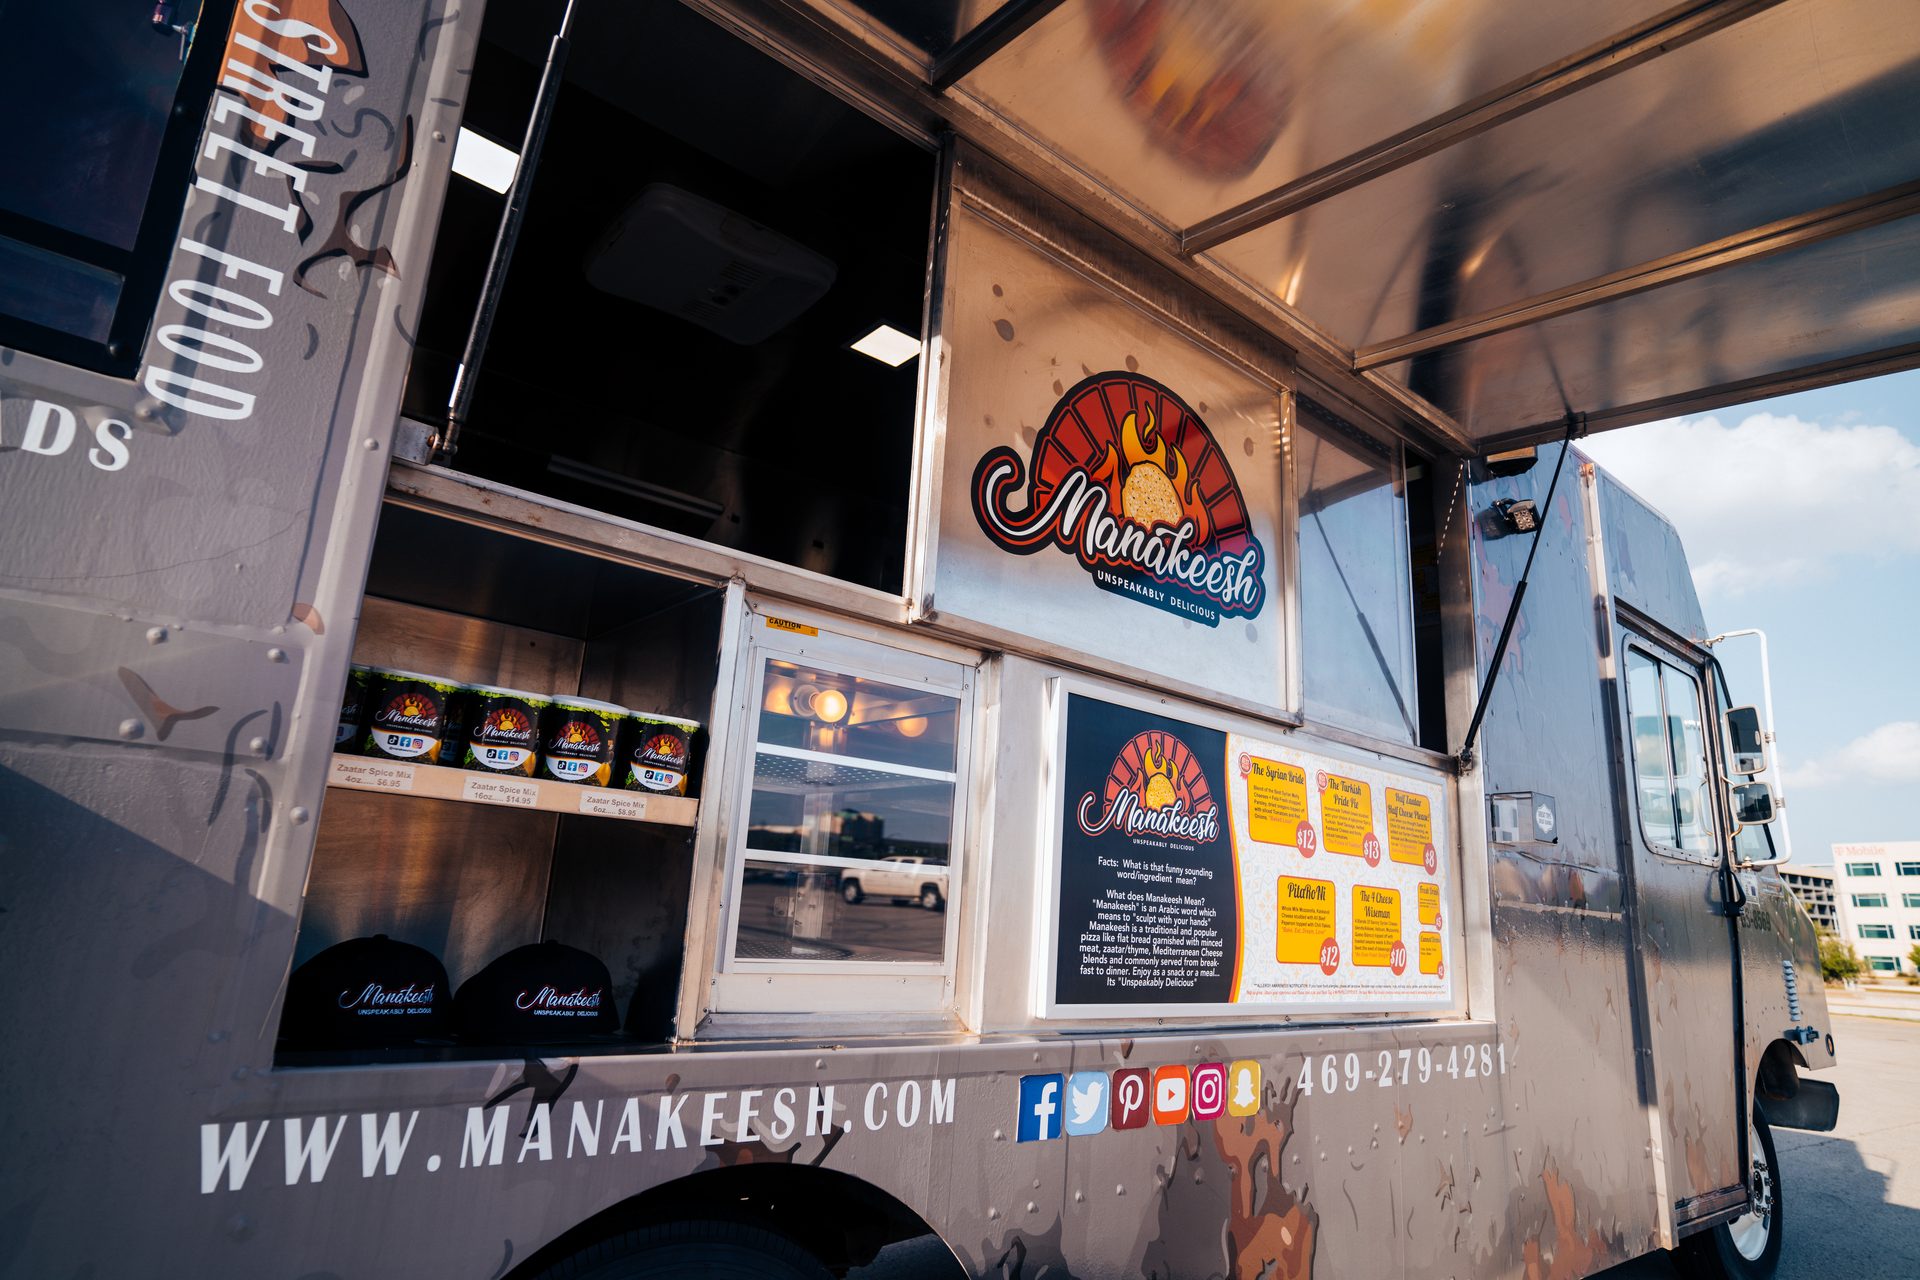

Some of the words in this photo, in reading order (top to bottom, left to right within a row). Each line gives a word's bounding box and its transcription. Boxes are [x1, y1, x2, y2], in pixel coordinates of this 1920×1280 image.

[194, 0, 338, 234] STREET
[144, 236, 285, 421] FOOD
[0, 391, 132, 471] DS
[1097, 569, 1165, 602] UNSPEAKABLY
[1170, 596, 1215, 620] DELICIOUS
[769, 617, 802, 629] CAUTION
[337, 764, 367, 774] Zaatar
[368, 767, 393, 777] Spice
[396, 770, 412, 779] Mix
[1252, 763, 1264, 776] The
[1266, 766, 1287, 781] Syrian
[472, 782, 497, 790] Zaatar
[499, 785, 520, 794] Spice
[523, 788, 536, 796] Mix
[1328, 779, 1339, 790] The
[506, 795, 531, 804] $14.95
[587, 796, 610, 804] Zaatar
[611, 799, 631, 807] Spice
[618, 808, 636, 816] $8.95
[1133, 838, 1167, 848] UNSPEAKABLY
[1170, 842, 1194, 851] DELICIOUS
[1297, 829, 1314, 849] $12
[1364, 840, 1379, 859] $13
[1425, 850, 1434, 868] $8
[1098, 856, 1119, 867] Facts:
[1123, 859, 1142, 869] What
[1143, 861, 1149, 870] is
[1150, 862, 1164, 872] that
[1165, 864, 1184, 876] funny
[1184, 866, 1213, 879] sounding
[1117, 870, 1173, 883] word/ingredient
[1176, 876, 1197, 885] mean?
[1106, 889, 1126, 899] What
[1127, 891, 1144, 901] does
[1146, 893, 1183, 904] Manakeesh
[1184, 897, 1205, 906] Mean?
[1360, 890, 1370, 903] The
[1141, 903, 1147, 912] is
[1158, 905, 1180, 915] Arabic
[1181, 907, 1198, 916] word
[1199, 908, 1216, 917] which
[1097, 913, 1121, 921] means
[1158, 915, 1173, 923] with
[1174, 918, 1188, 926] your
[1089, 921, 1130, 932] Manakeesh
[1131, 924, 1137, 932] is
[1145, 925, 1179, 935] traditional
[1180, 927, 1192, 936] and
[1193, 927, 1217, 938] popular
[1081, 934, 1100, 944] pizza
[1102, 933, 1115, 942] like
[1117, 933, 1129, 943] flat
[1131, 934, 1150, 944] bread
[1153, 936, 1185, 947] garnished
[1186, 937, 1199, 946] with
[1201, 938, 1223, 947] minced
[1079, 945, 1101, 953] meat,
[1153, 946, 1200, 956] Mediterranean
[1201, 949, 1223, 957] Cheese
[1320, 946, 1338, 966] $12
[1391, 948, 1405, 967] $10
[1083, 954, 1107, 964] blends
[1109, 956, 1123, 964] and
[1124, 957, 1159, 967] commonly
[1160, 957, 1182, 966] served
[1183, 958, 1199, 966] from
[1200, 958, 1219, 967] break-
[1080, 965, 1094, 975] fast
[1096, 967, 1104, 975] to
[1106, 966, 1131, 976] dinner.
[1132, 967, 1150, 978] Enjoy
[1167, 968, 1185, 976] snack
[1107, 978, 1115, 986] Its
[1297, 1043, 1508, 1096] 469-279-4281
[202, 1077, 956, 1195] WWW.MANAKEESH.COM
